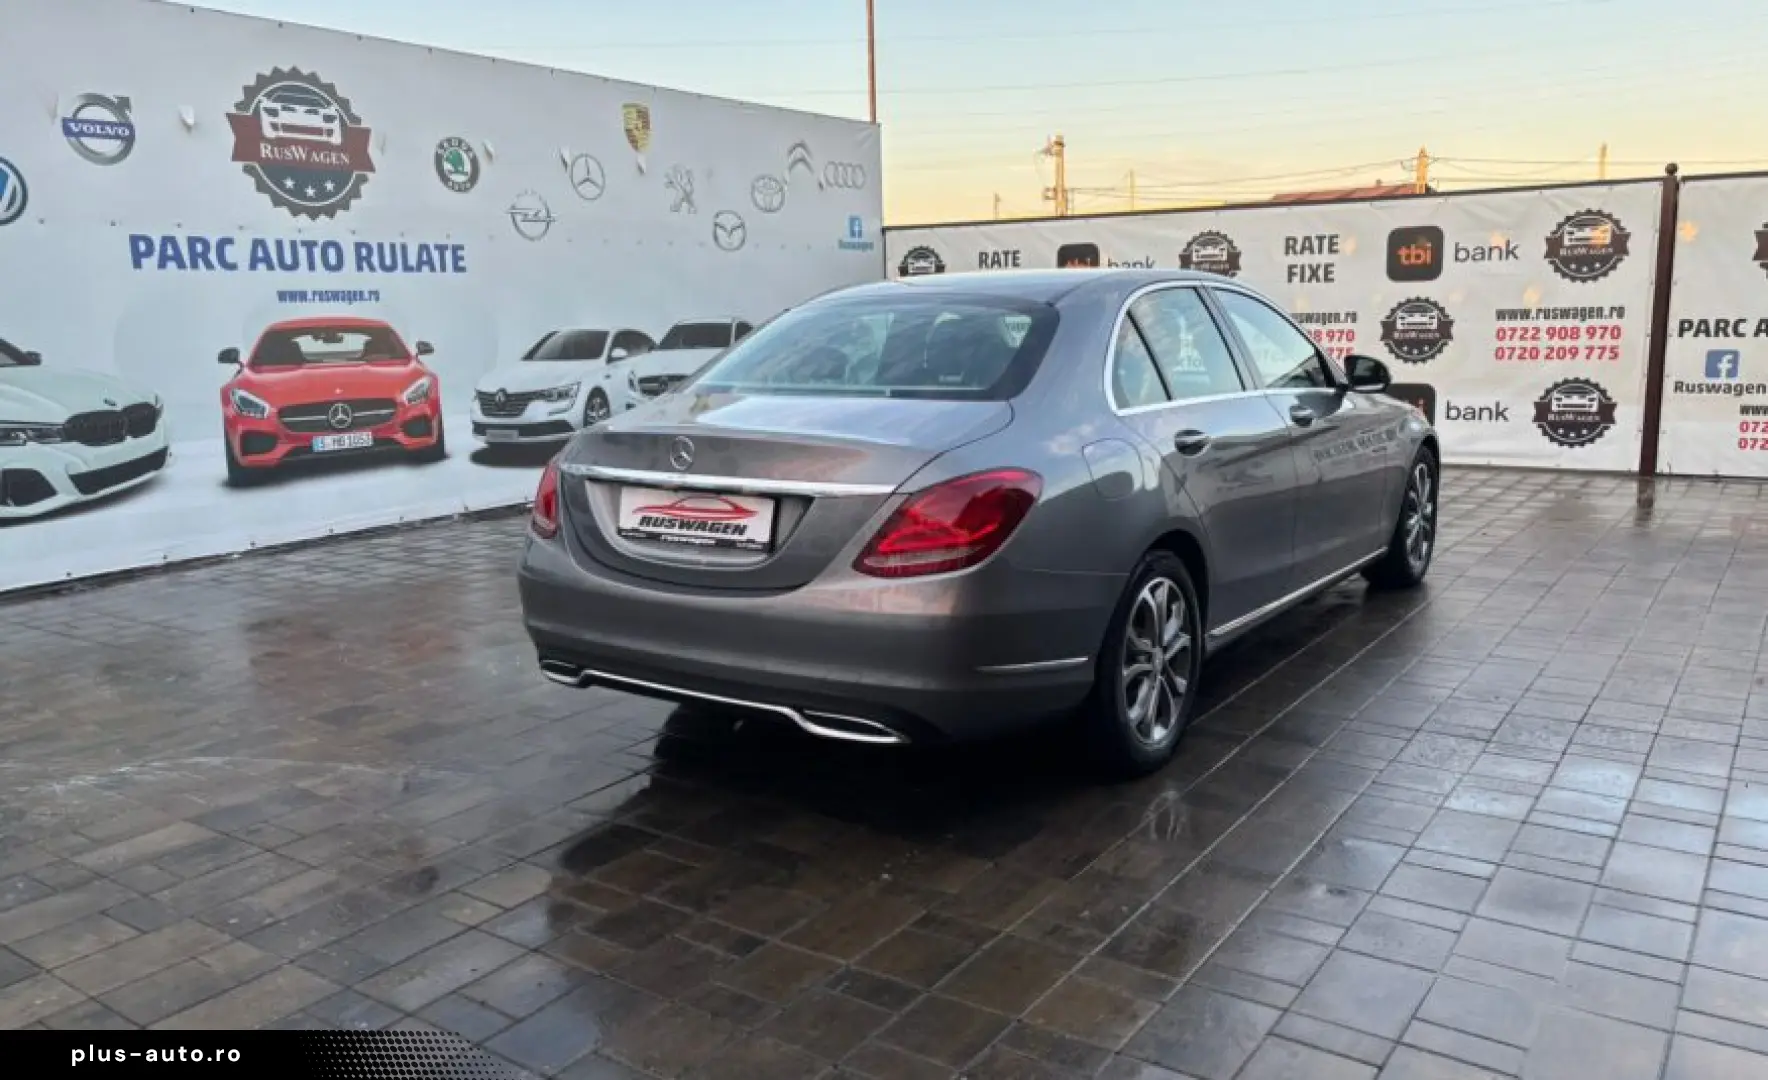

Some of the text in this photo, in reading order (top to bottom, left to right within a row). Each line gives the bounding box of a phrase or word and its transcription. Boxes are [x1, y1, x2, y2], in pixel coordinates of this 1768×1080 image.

[68, 122, 130, 136] VOLVO
[129, 234, 467, 273] PARC AUTO RULATE
[1284, 233, 1340, 255] RATE
[1397, 239, 1519, 265] tbi bank
[978, 249, 1021, 269] RATE
[1287, 262, 1335, 283] FIXE
[276, 289, 380, 304] www.ruswagen.ro
[1495, 306, 1625, 322] www.ruswagen.ro
[1325, 328, 1355, 342] 970
[1496, 325, 1622, 341] 0722 908 970
[1679, 318, 1747, 338] PARC
[1495, 345, 1620, 360] 0720 209 775
[1673, 381, 1767, 397] Ruswagen
[1445, 399, 1509, 422] bank
[638, 515, 748, 536] RUSWAGEN
